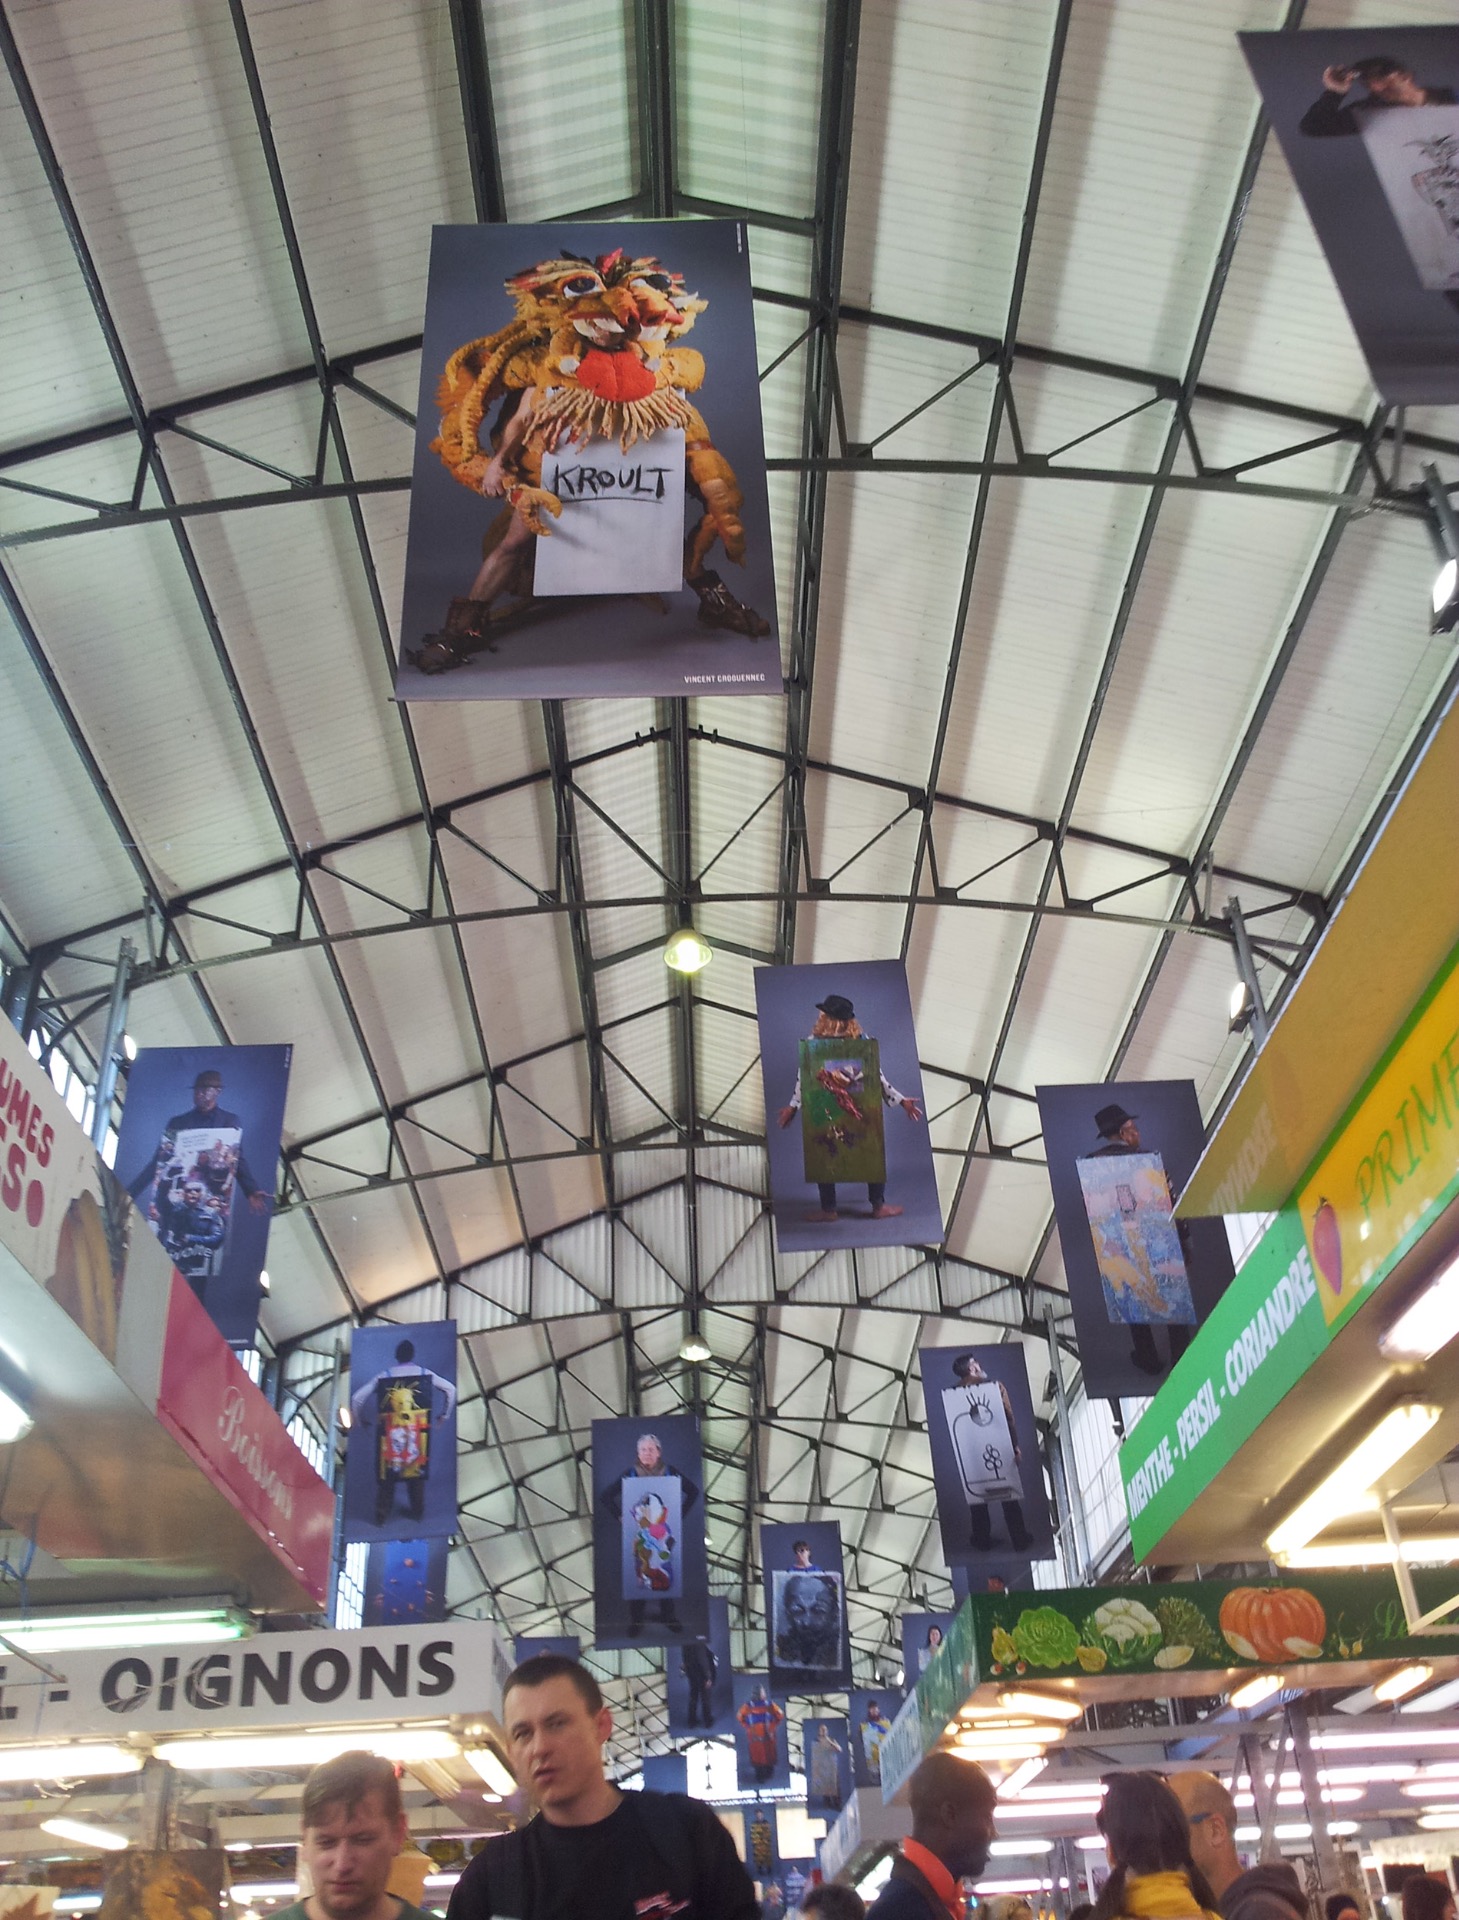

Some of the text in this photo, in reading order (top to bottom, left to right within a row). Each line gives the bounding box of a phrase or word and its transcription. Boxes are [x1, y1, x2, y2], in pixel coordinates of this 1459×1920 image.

[555, 463, 675, 499] KROULT
[684, 675, 715, 683] VINCENT
[1126, 1435, 1176, 1522] MENTHE
[1175, 1378, 1222, 1460] PERSIL
[1224, 1244, 1317, 1397] CORIANDRE
[101, 1640, 456, 1714] OIGNONS
